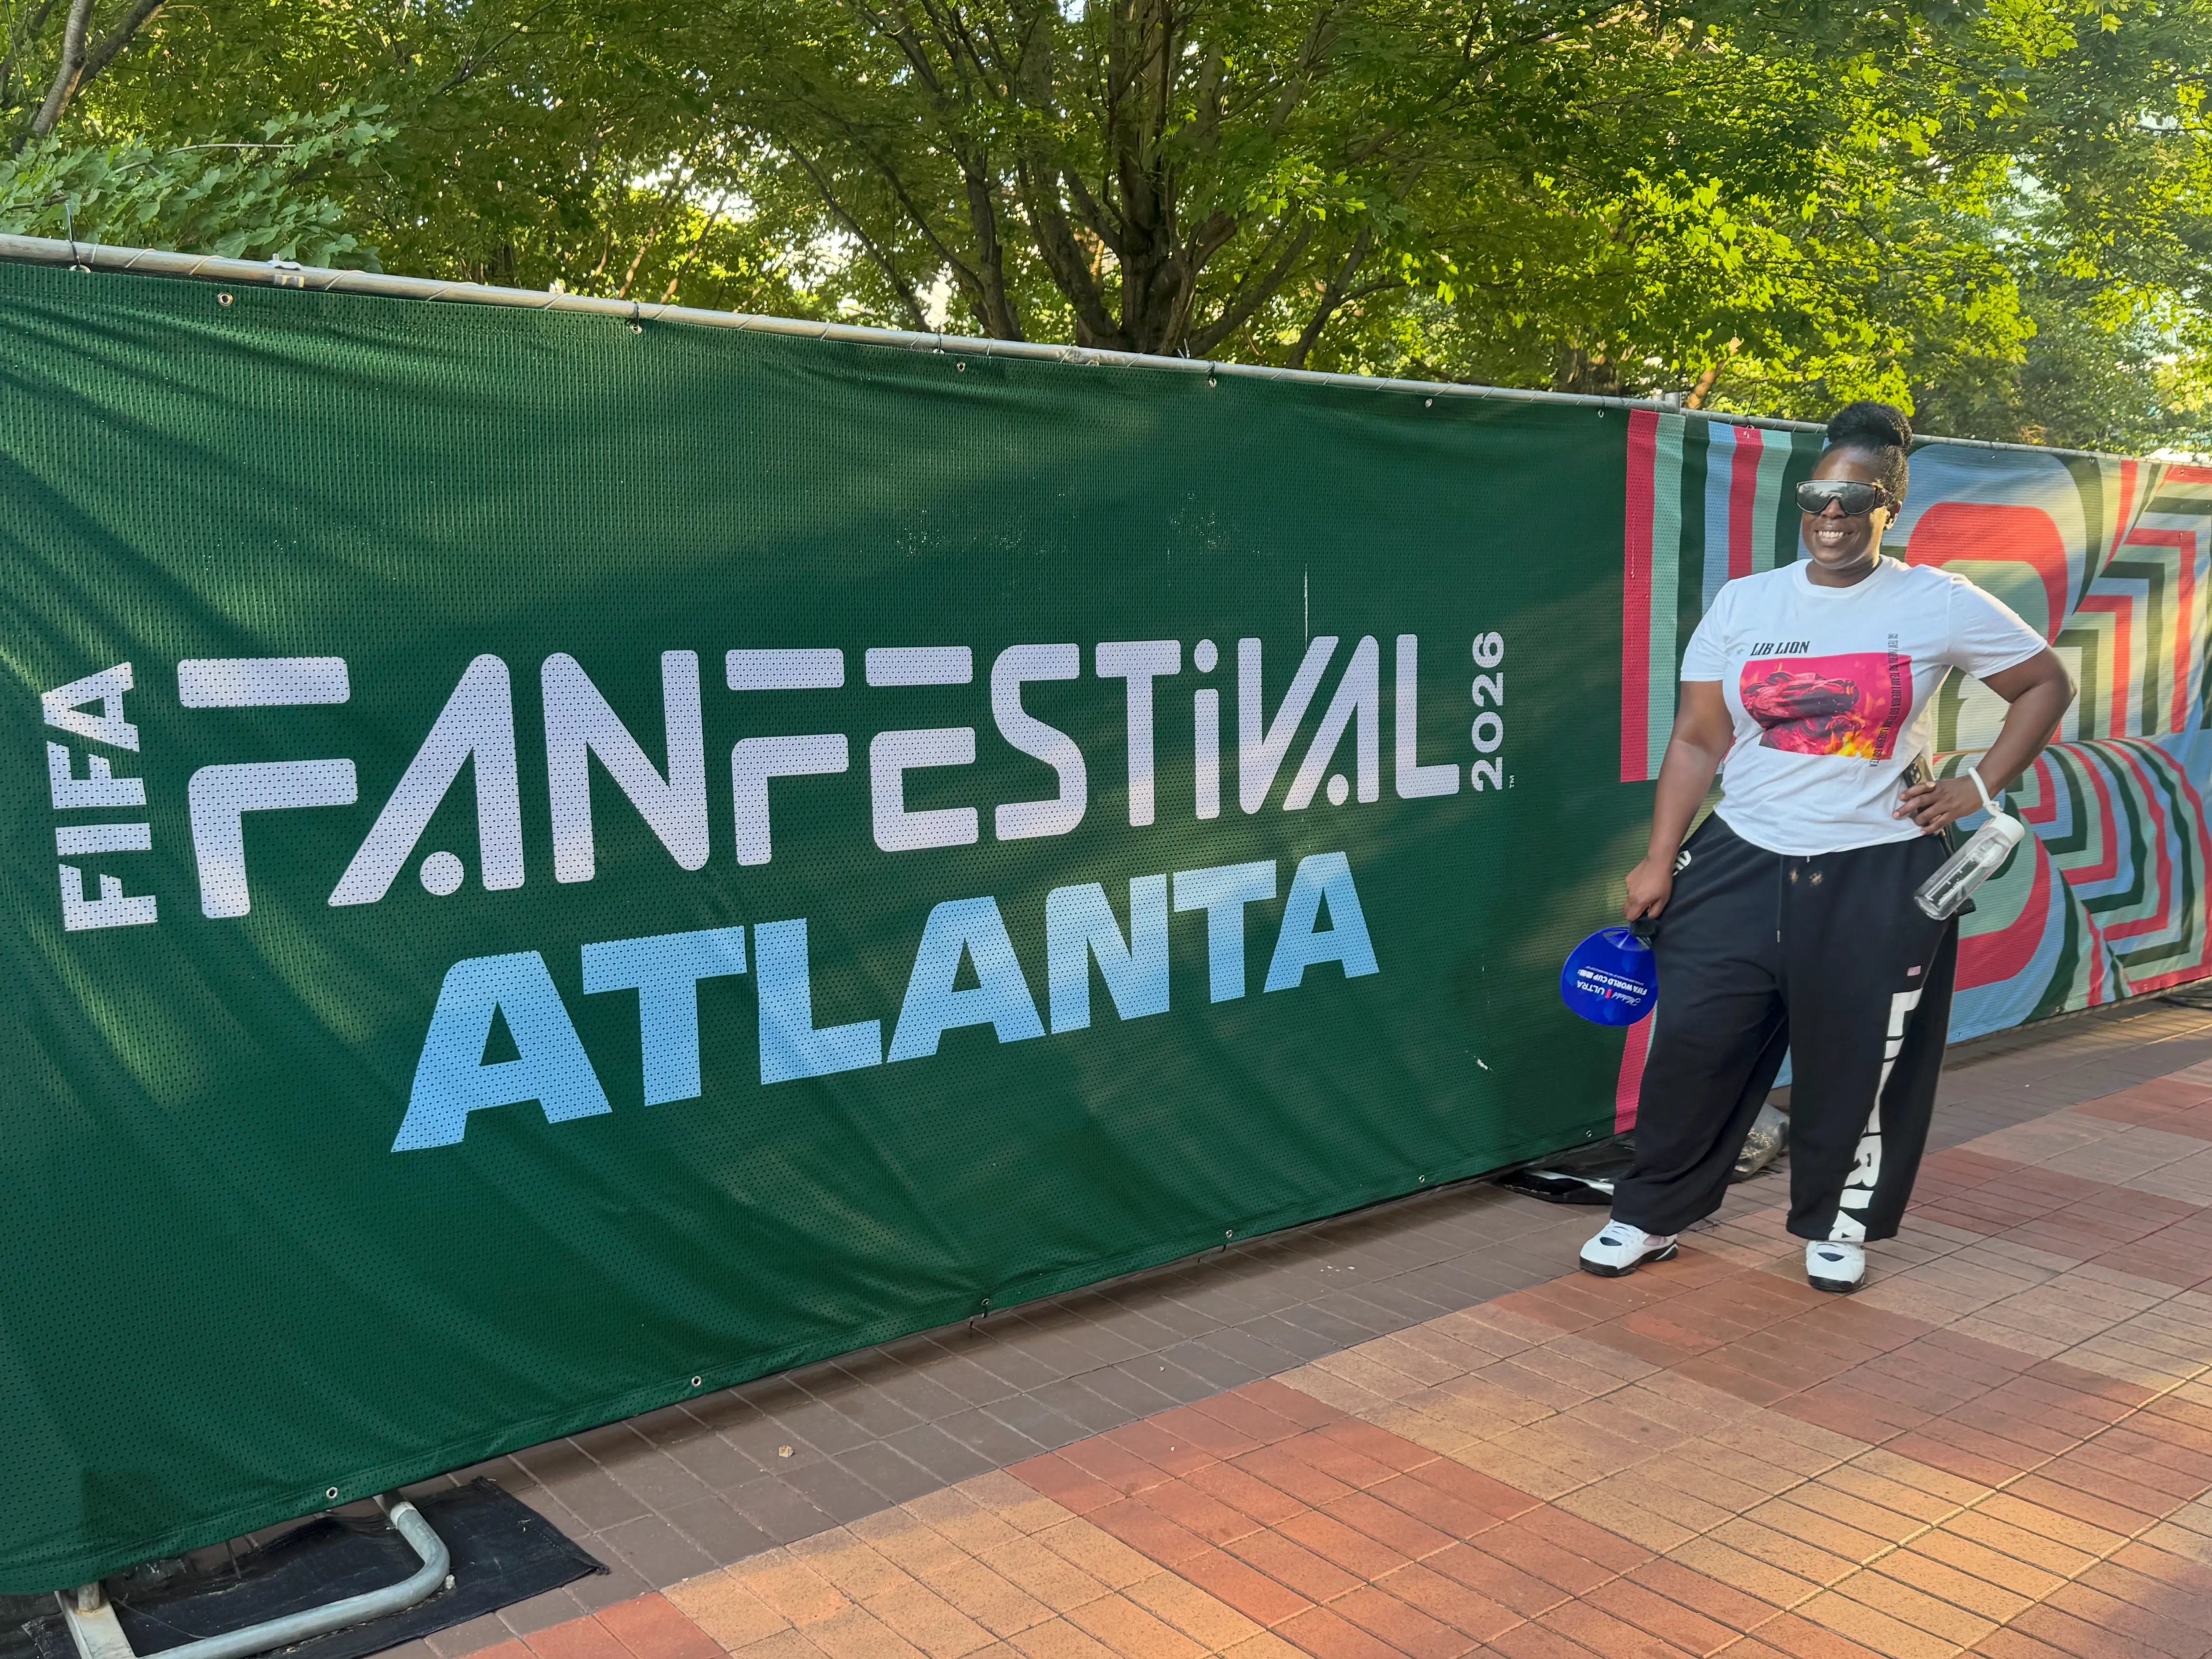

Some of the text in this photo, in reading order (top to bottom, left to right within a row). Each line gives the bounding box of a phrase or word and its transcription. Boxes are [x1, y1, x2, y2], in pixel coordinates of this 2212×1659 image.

[1750, 641, 1810, 656] LIB LION
[1471, 632, 1504, 791] 2026
[42, 661, 158, 931] FIFA
[1593, 974, 1608, 983] CUP
[1608, 978, 1632, 991] WORLD
[1577, 980, 1605, 995] ULTRA
[1632, 985, 1648, 995] FIFA
[391, 851, 1380, 1152] ATLANTA
